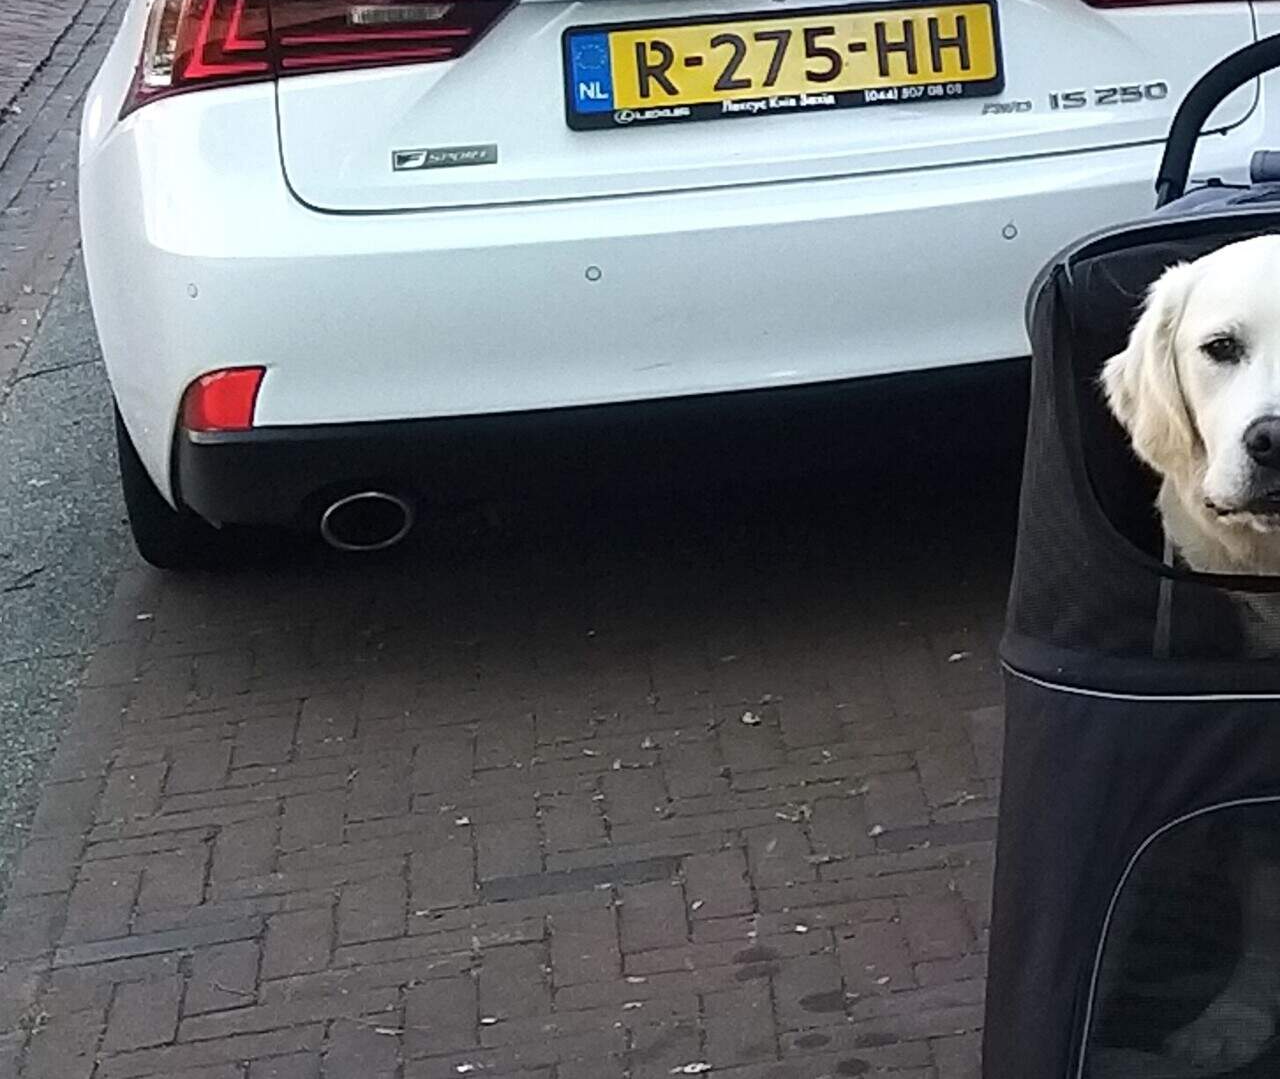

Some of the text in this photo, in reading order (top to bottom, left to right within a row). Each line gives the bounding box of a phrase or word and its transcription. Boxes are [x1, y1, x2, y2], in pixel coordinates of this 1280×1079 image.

[634, 15, 972, 99] R-275-HH
[579, 82, 608, 101] NL
[1049, 81, 1169, 110] IS 250
